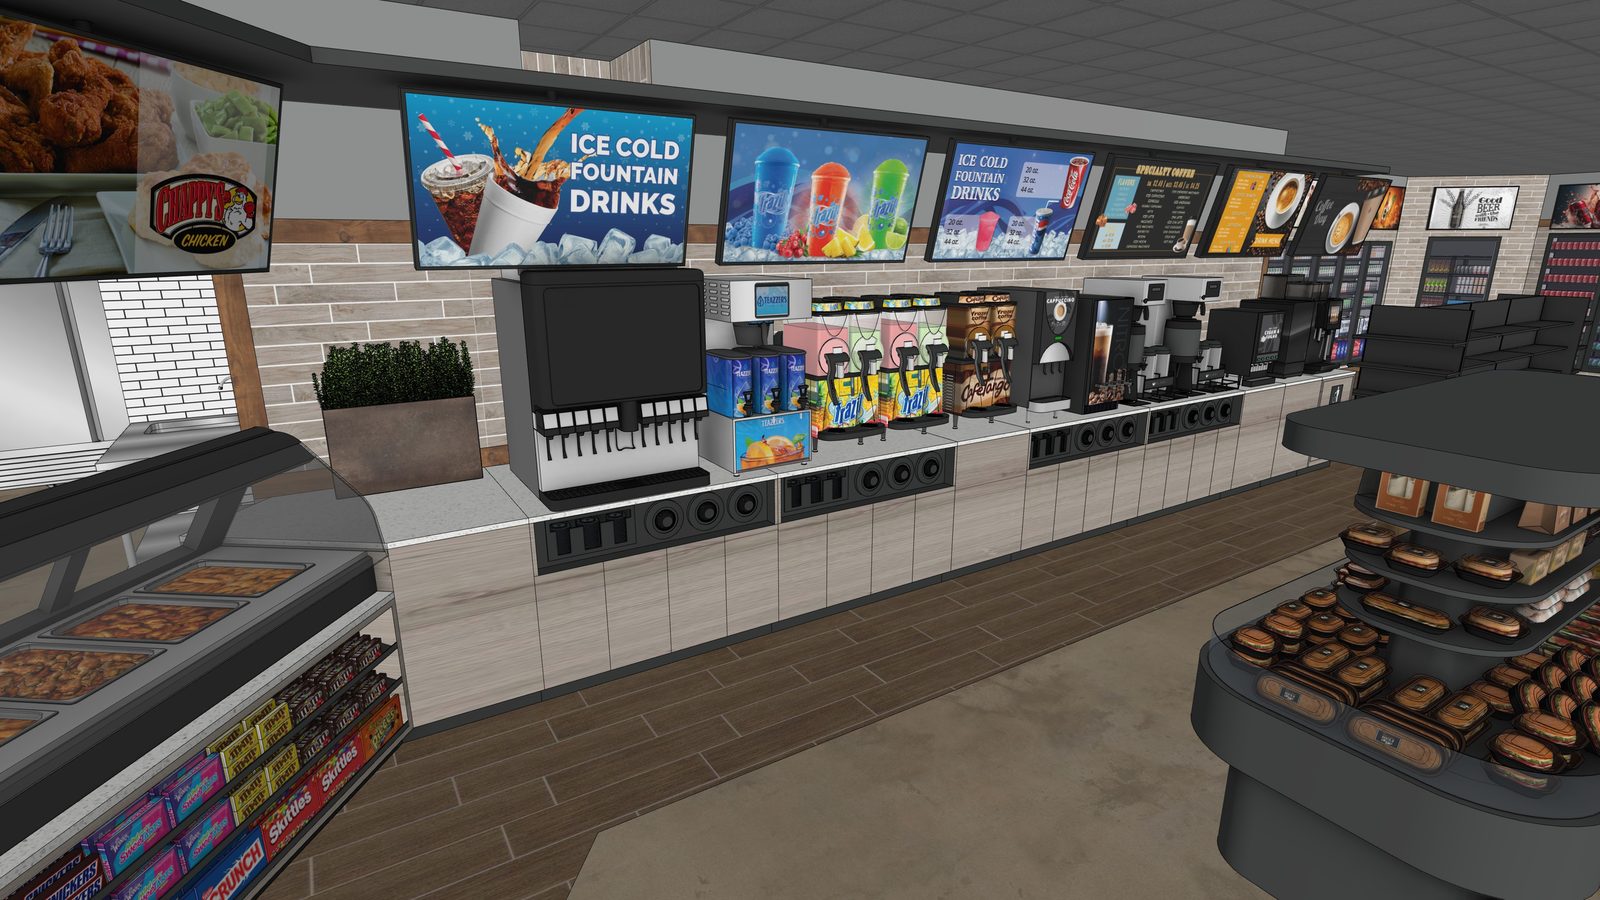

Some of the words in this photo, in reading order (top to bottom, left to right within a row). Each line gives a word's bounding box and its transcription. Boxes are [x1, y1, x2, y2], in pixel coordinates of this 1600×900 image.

[571, 133, 610, 155] ICE
[615, 137, 680, 160] COLD
[570, 161, 678, 185] FOUNTAIN
[958, 153, 977, 167] ICE
[980, 155, 1009, 169] COLD
[954, 170, 1006, 184] FOUNTAIN
[570, 189, 676, 216] DRINKS
[950, 185, 1001, 201] DRINKS
[155, 180, 226, 234] CHAPPY'S
[1476, 203, 1500, 213] BEER
[181, 233, 229, 248] CHICKEN
[321, 746, 358, 792] Skittles
[269, 791, 312, 844] Skittles
